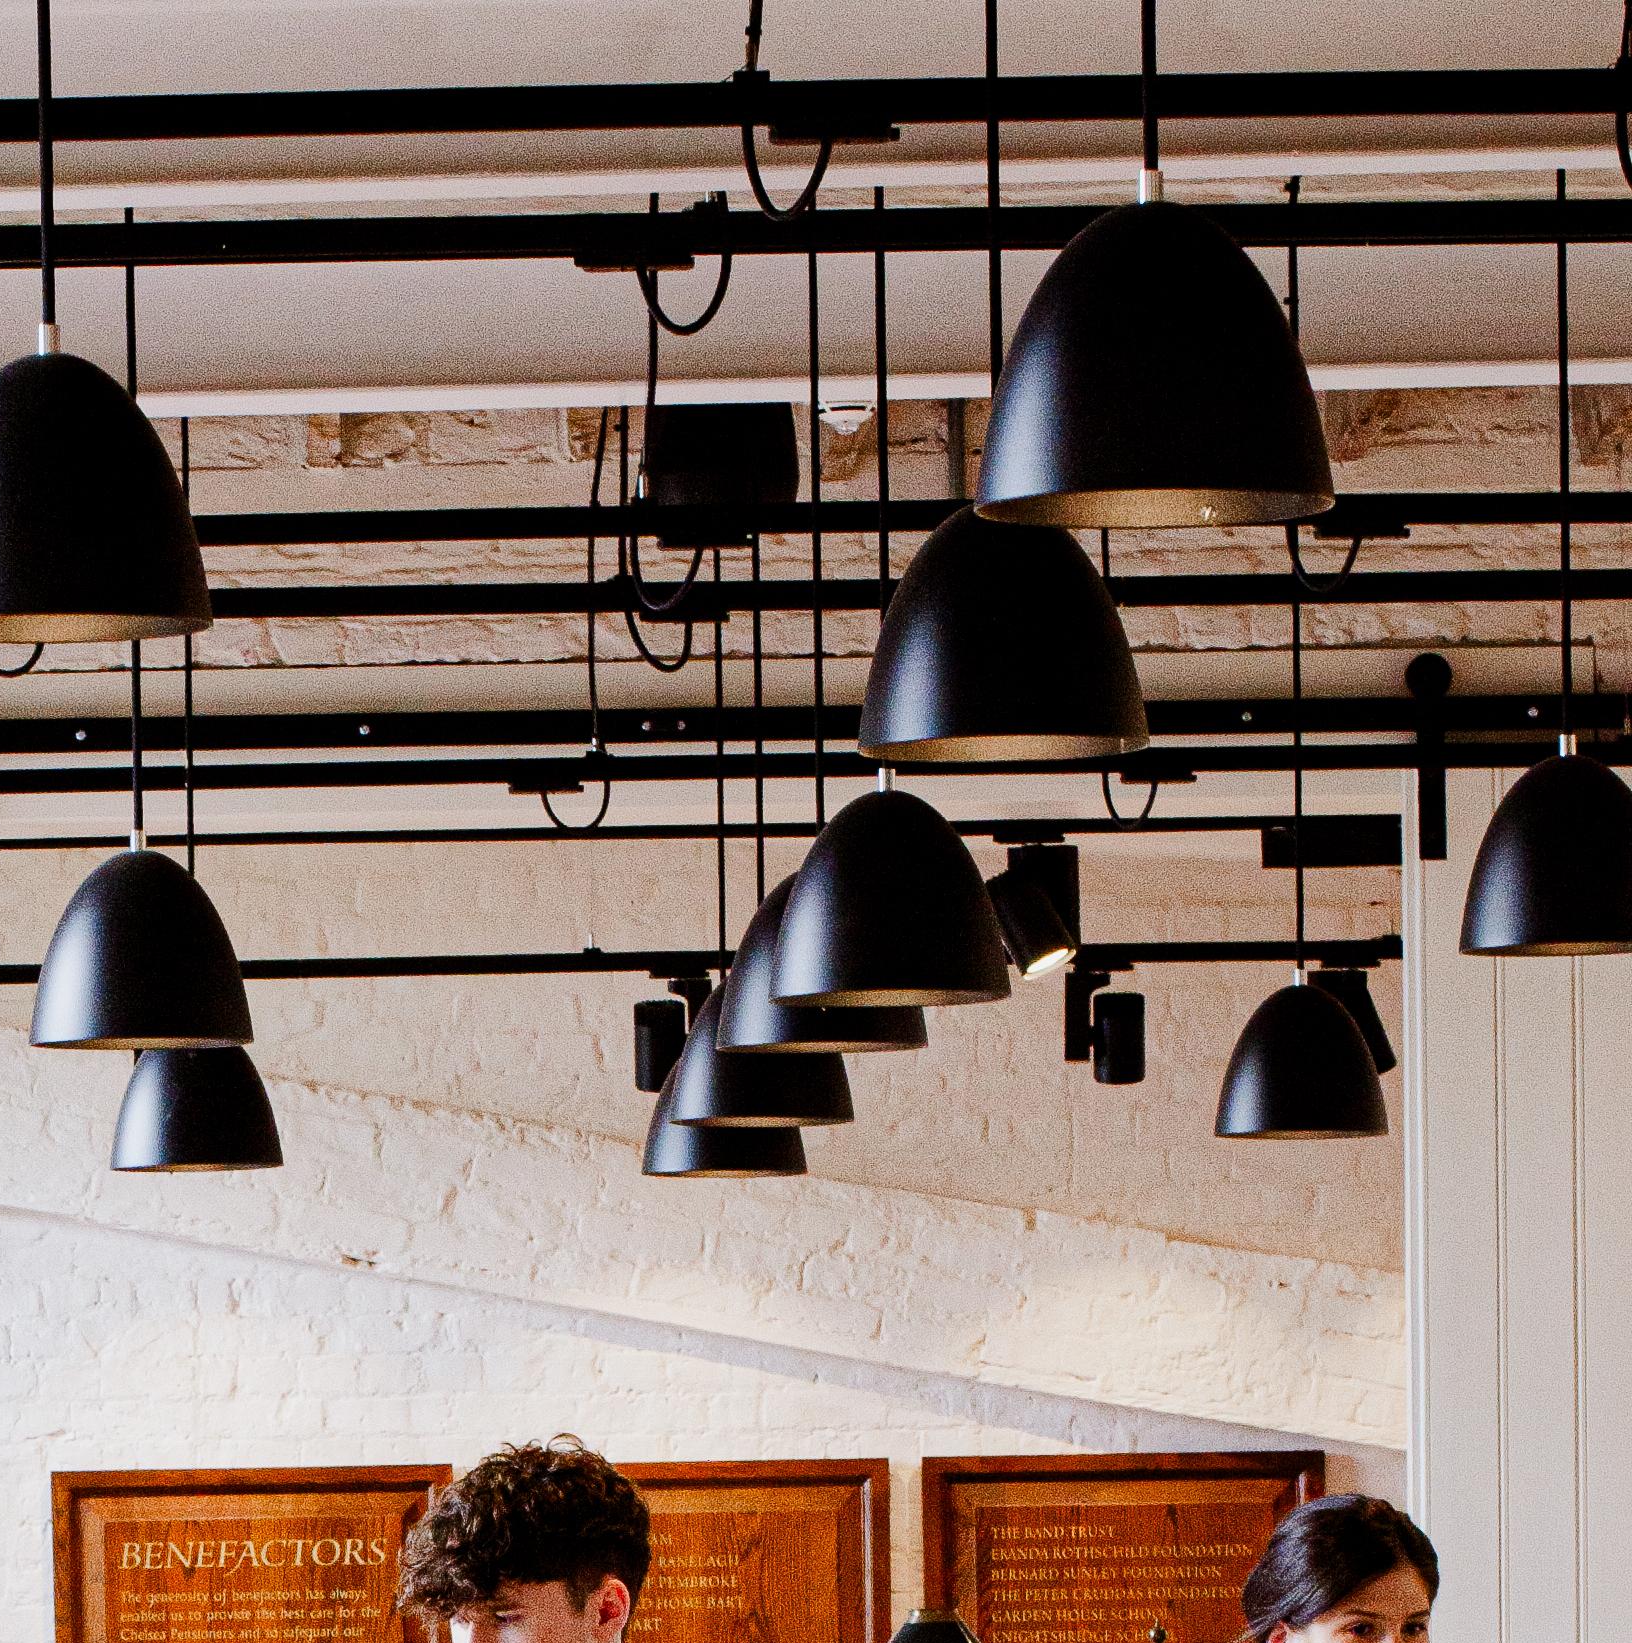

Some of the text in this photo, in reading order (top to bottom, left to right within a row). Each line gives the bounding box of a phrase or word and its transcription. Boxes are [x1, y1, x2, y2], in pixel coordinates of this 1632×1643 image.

[991, 1524, 1115, 1539] THE BAND TRUST
[118, 1538, 387, 1577] BENEFACTORS
[991, 1543, 1253, 1561] ERANDA ROTHSCHILD FOUNDATION
[658, 1555, 739, 1568] RANELAGH
[991, 1565, 1223, 1581] BERNARD SUNLEY FOUNDATION
[659, 1575, 739, 1588] PEMBROKE
[120, 1588, 367, 1607] The generosity of benefactors has always
[656, 1597, 702, 1609] HOME
[992, 1589, 1020, 1603] THE
[1025, 1588, 1069, 1601] PETER
[1072, 1587, 1143, 1601] CRUDDAS
[120, 1606, 381, 1622] enabled us to provide the best care for the
[991, 1610, 1052, 1623] GARDEN
[1057, 1609, 1107, 1622] HOUSE
[120, 1625, 365, 1641] Chelsea Pensioners and so safeguard our
[992, 1630, 1111, 1643] KNIGHTSBRIDGE
